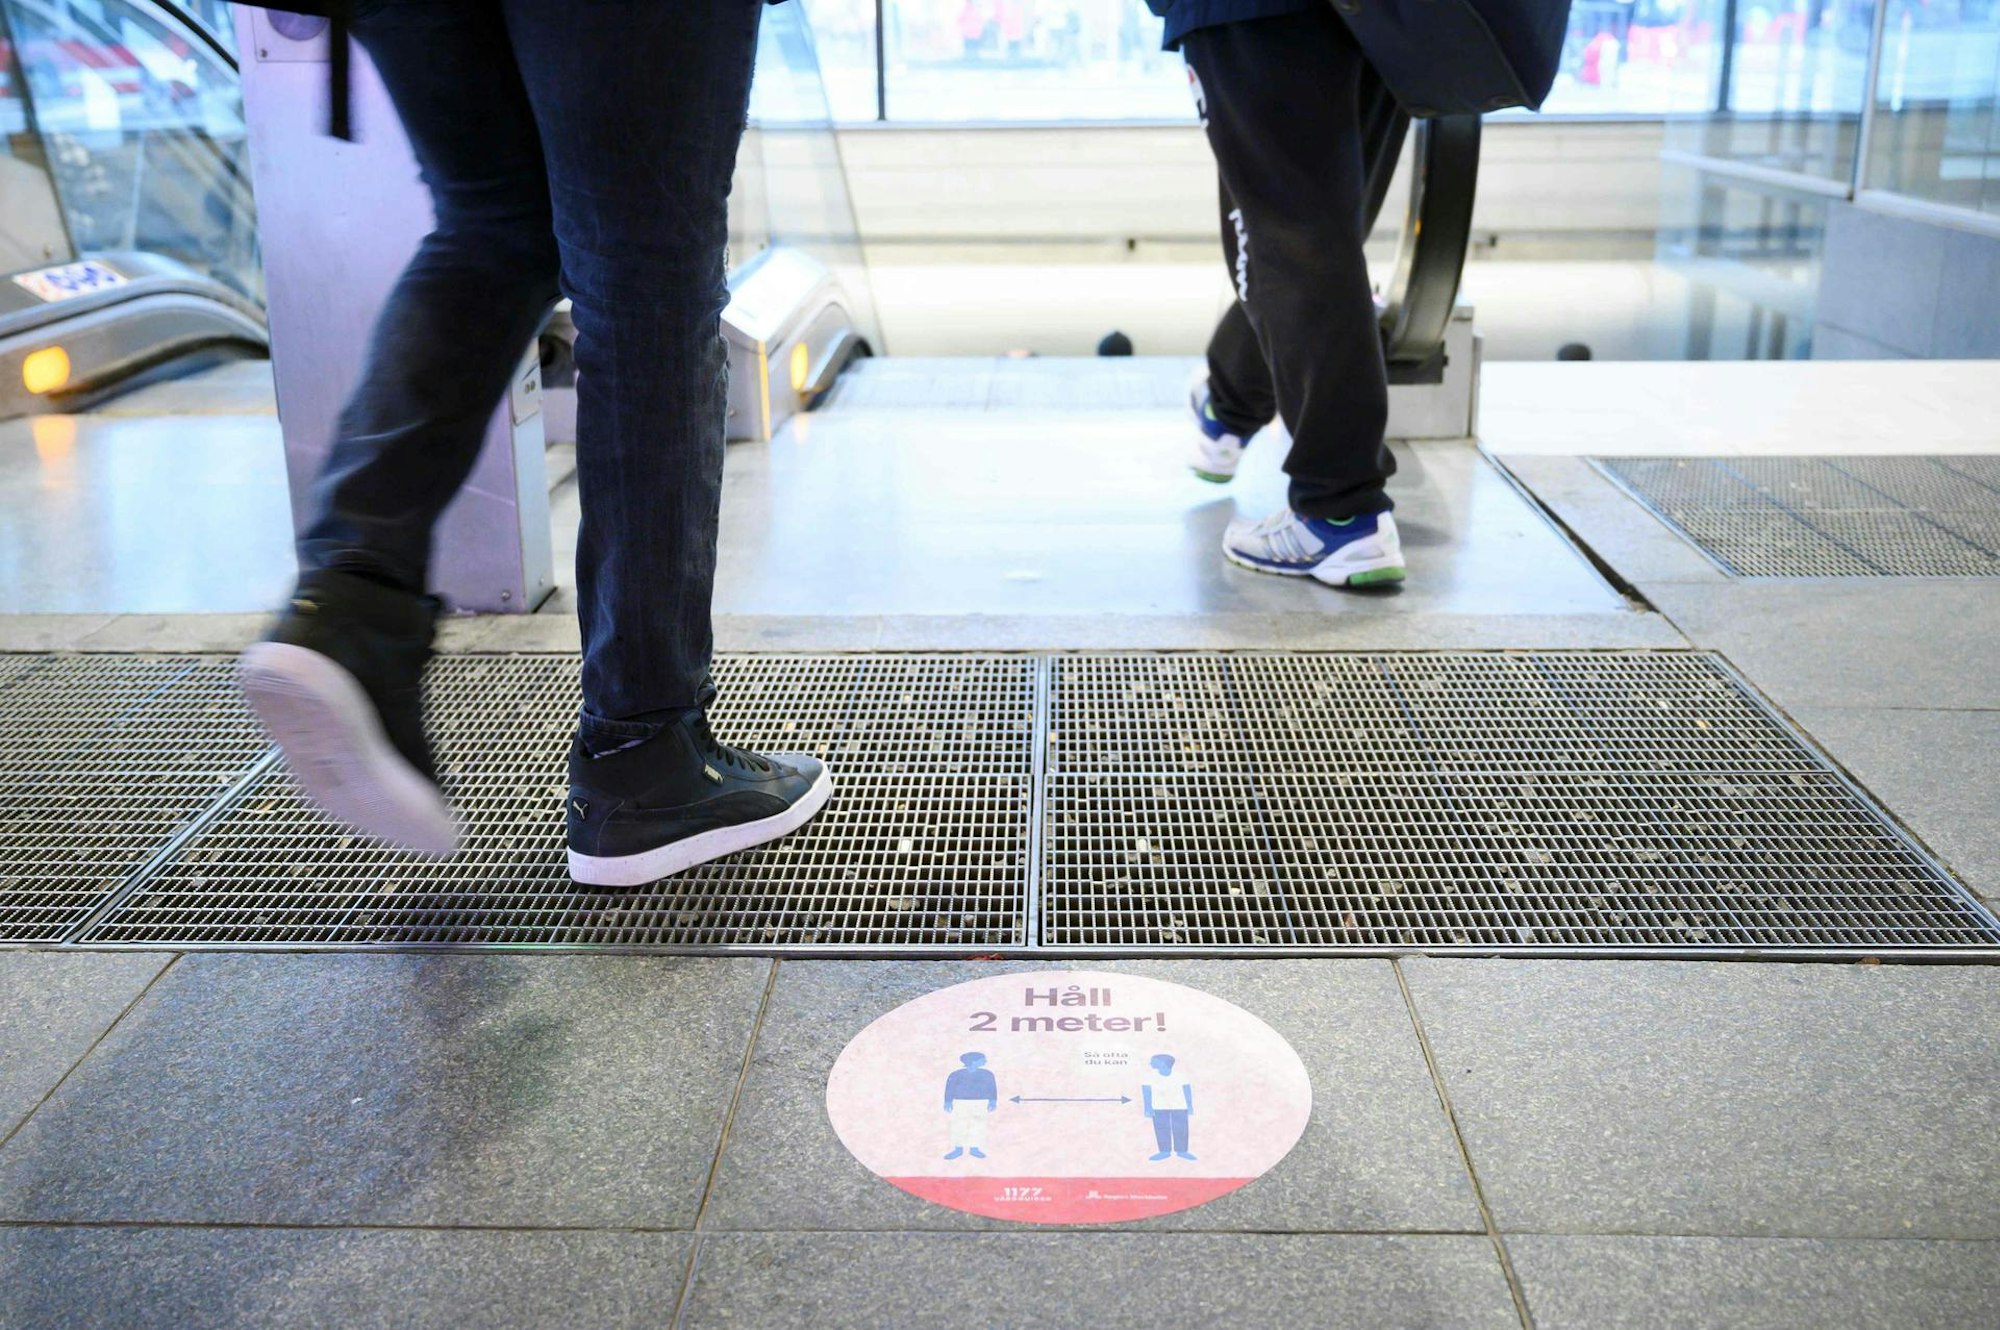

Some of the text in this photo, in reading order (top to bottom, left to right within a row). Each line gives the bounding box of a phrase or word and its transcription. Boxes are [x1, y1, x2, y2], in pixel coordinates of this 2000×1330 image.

[1024, 984, 1111, 1007] Håll
[968, 1011, 1167, 1032] 2 meter!
[1003, 1186, 1043, 1197] 1177
